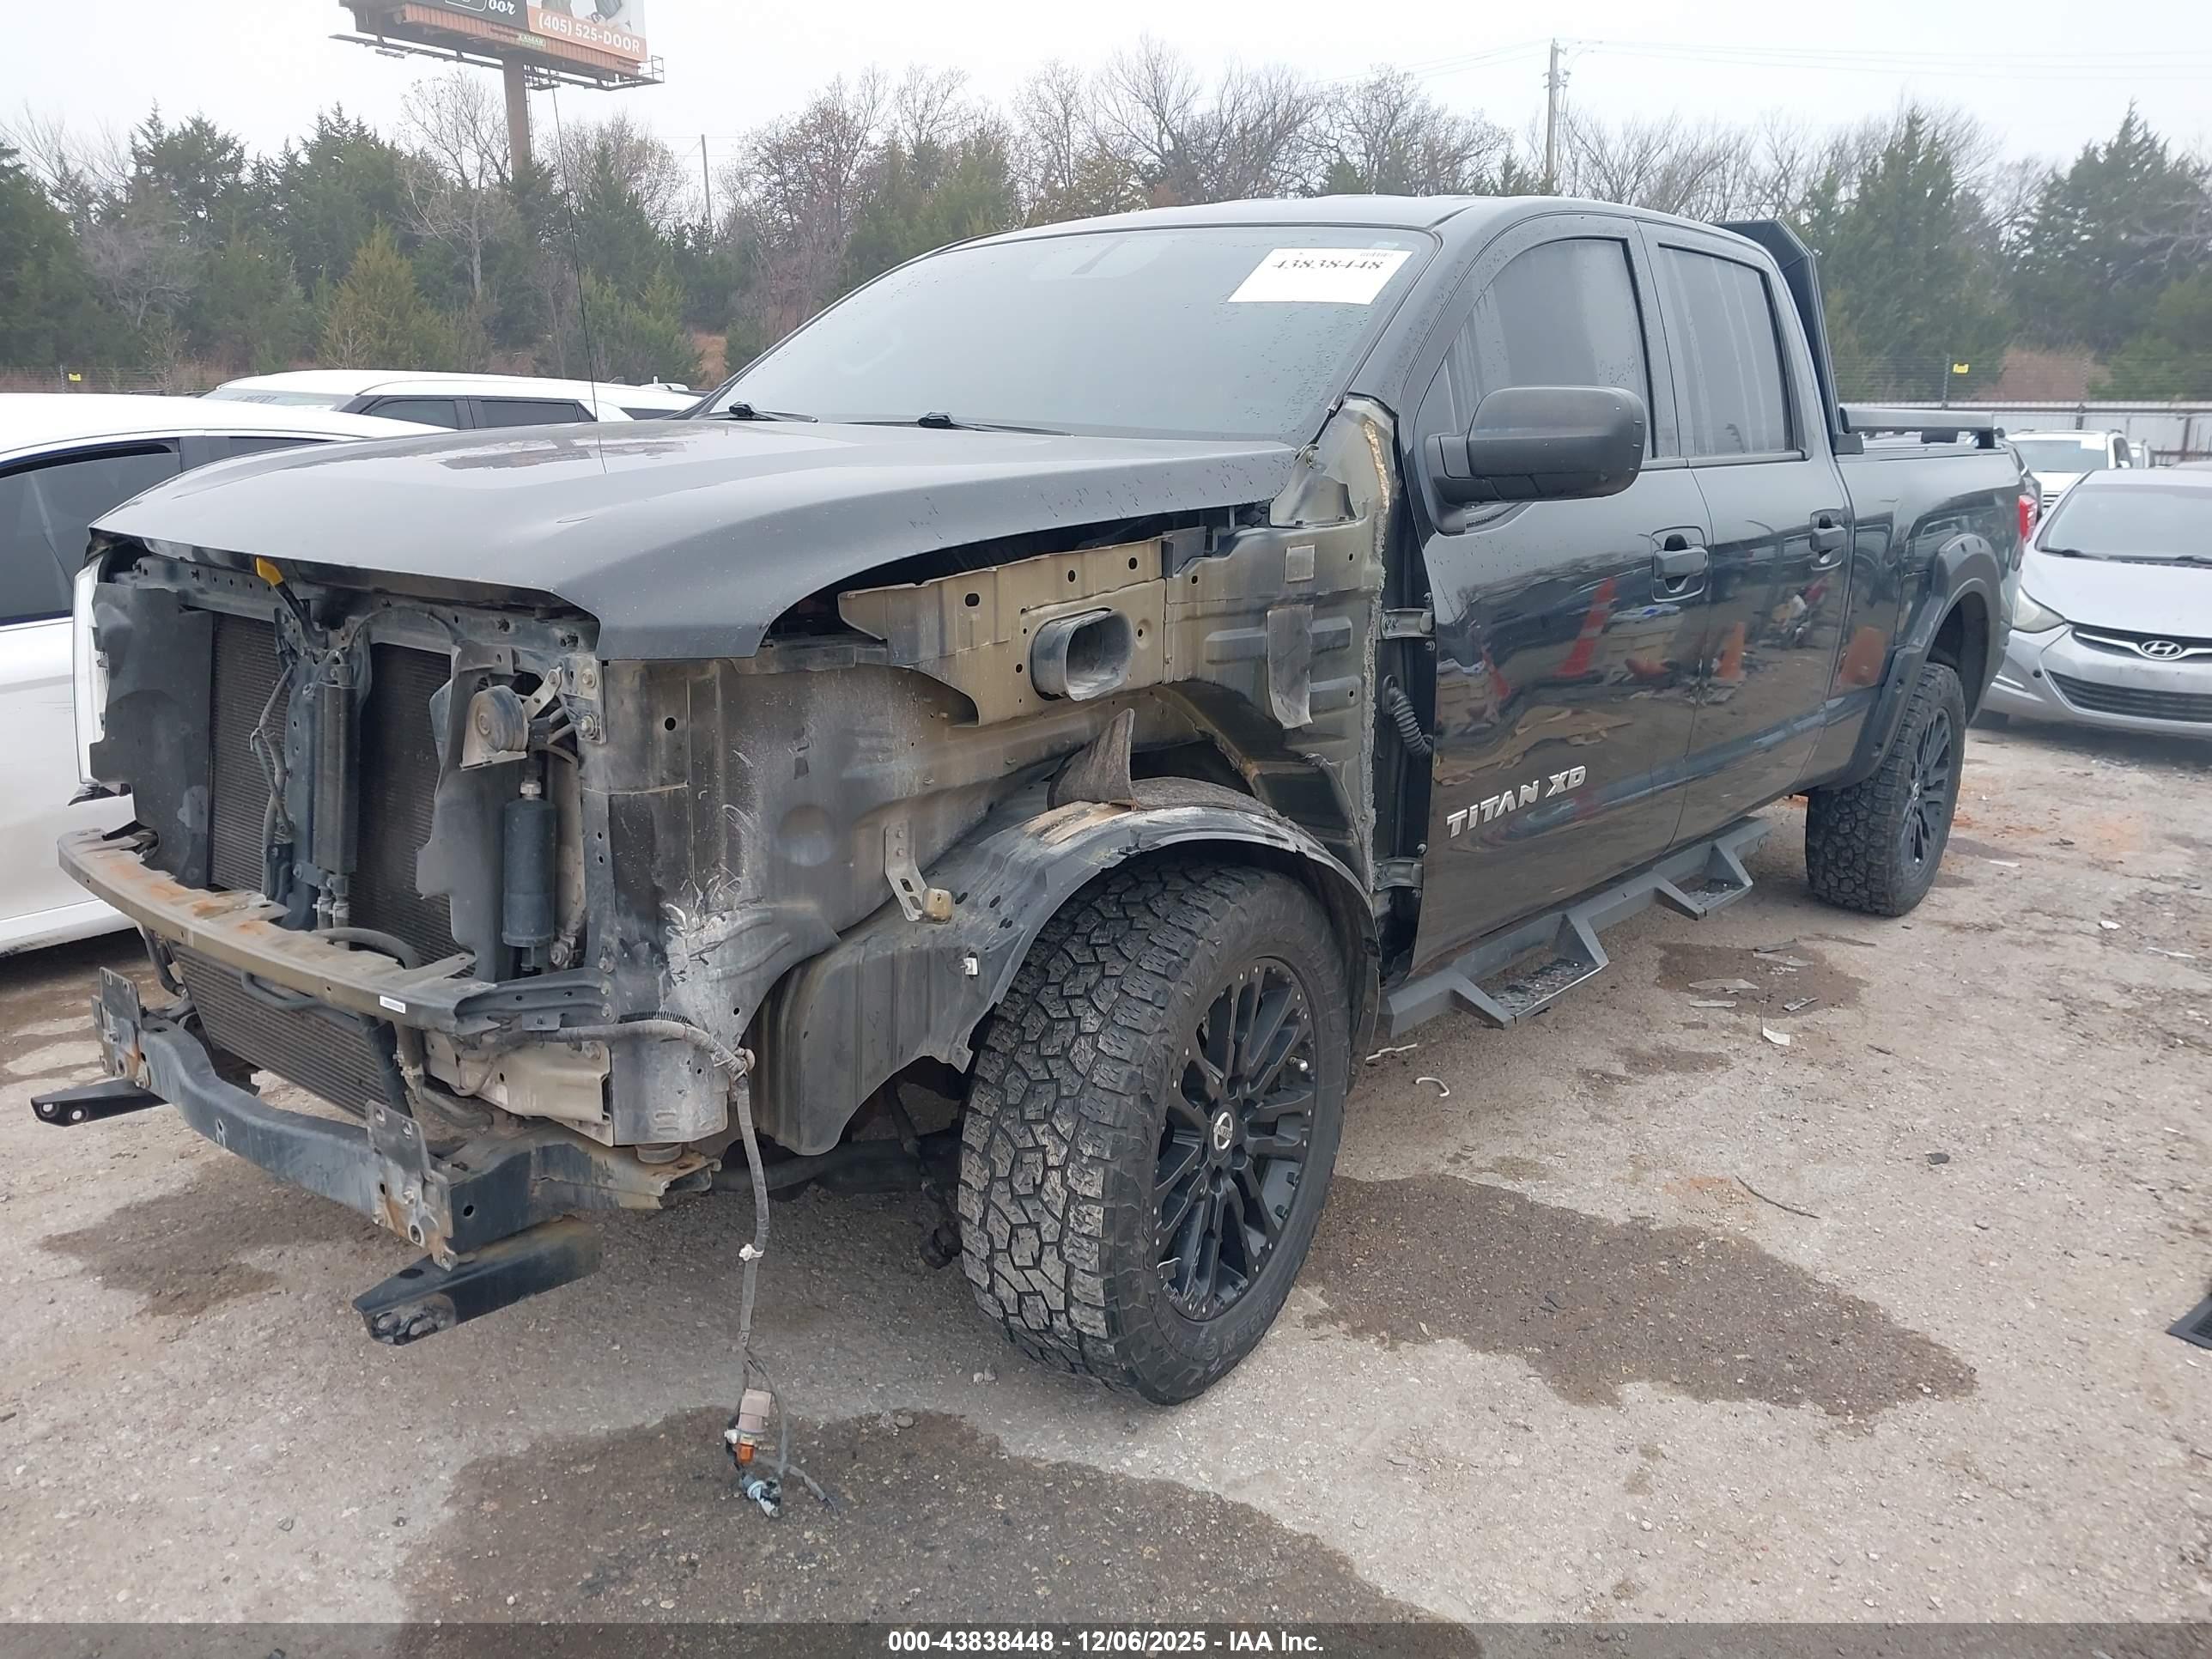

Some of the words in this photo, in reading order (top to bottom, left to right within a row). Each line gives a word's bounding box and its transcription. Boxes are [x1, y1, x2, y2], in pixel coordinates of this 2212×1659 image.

[538, 12, 572, 36] (405)
[574, 23, 640, 53] 525-DOOR
[1272, 259, 1383, 269] 43838448
[1446, 780, 1539, 839] TITAN
[1546, 765, 1586, 798] XD
